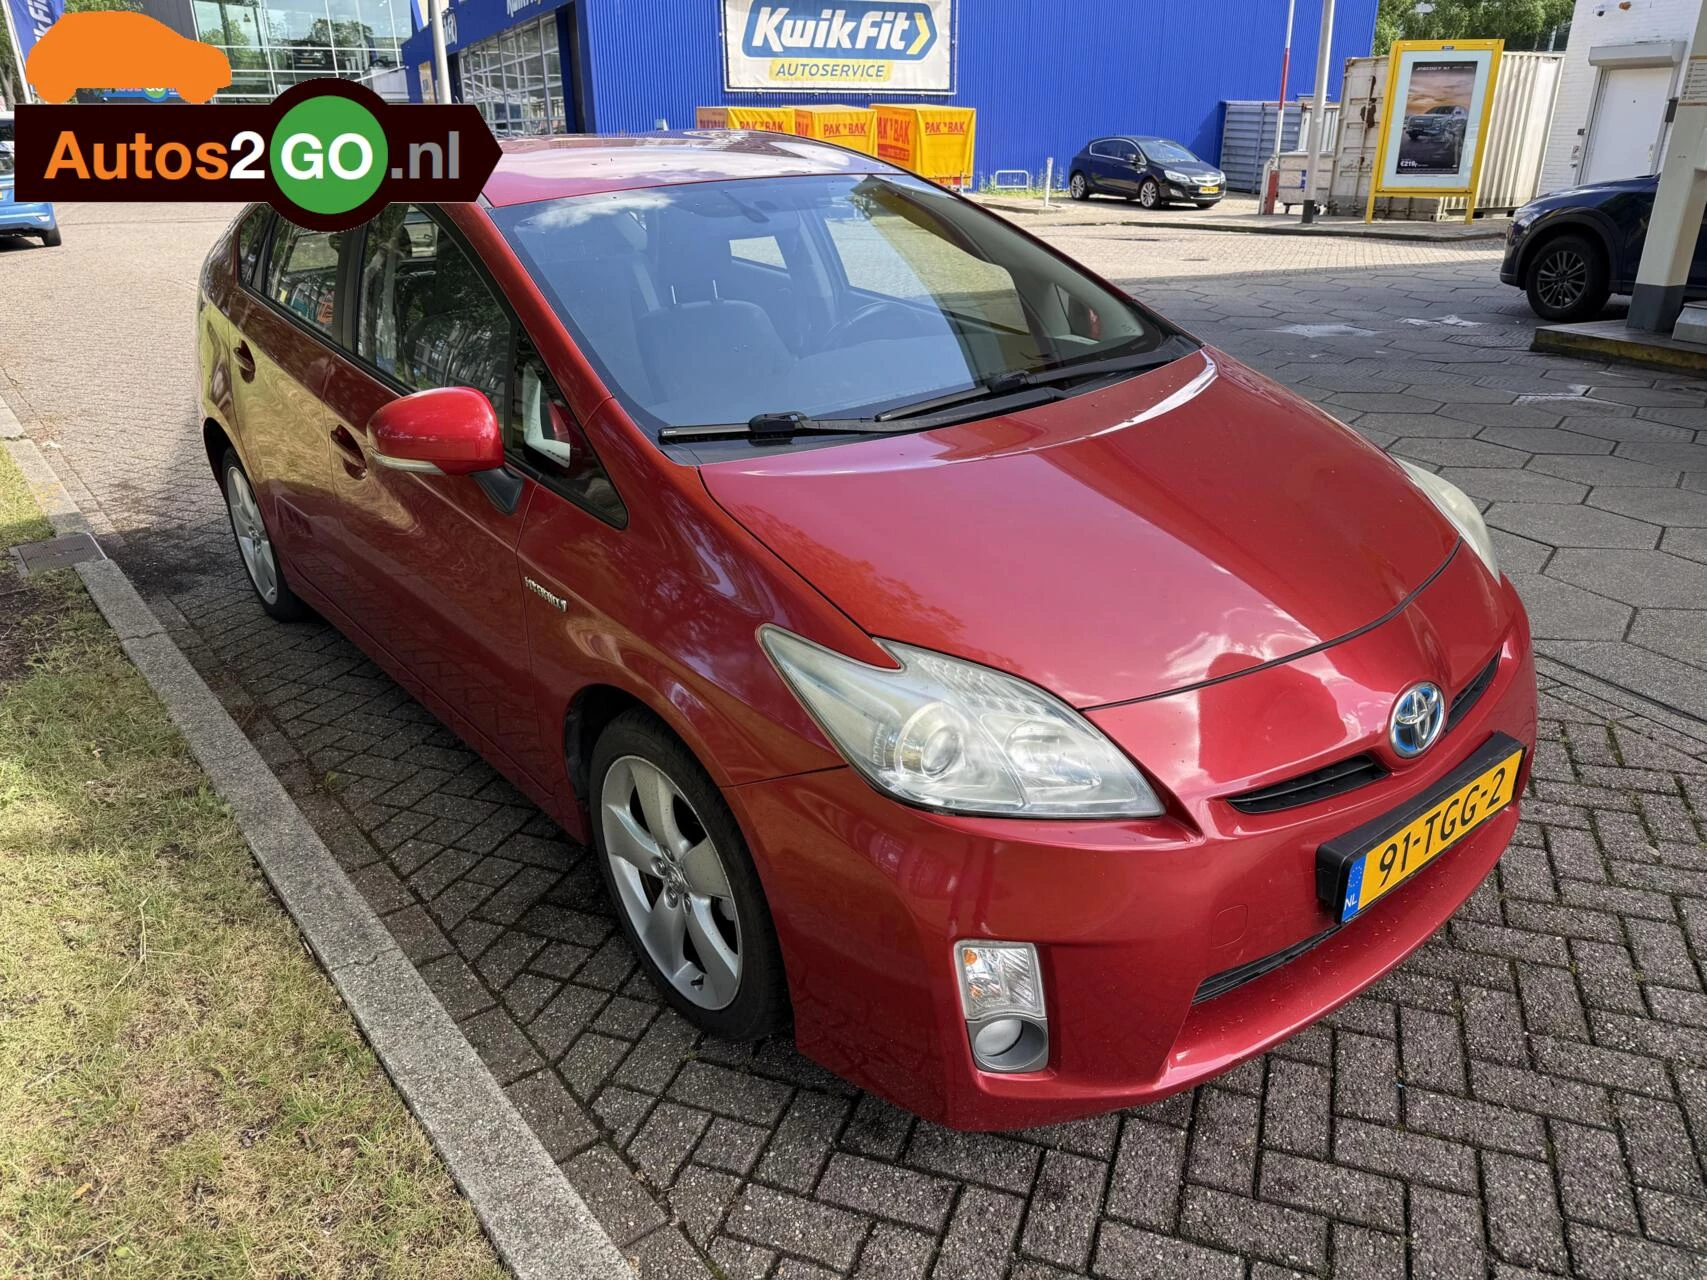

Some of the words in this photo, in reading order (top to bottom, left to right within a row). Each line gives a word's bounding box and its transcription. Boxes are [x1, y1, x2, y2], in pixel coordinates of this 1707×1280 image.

[776, 63, 885, 78] AUTOSERVICE
[823, 123, 841, 135] PAK
[848, 122, 866, 134] BAK
[925, 121, 941, 133] PAK
[947, 121, 965, 133] BAK
[1379, 766, 1505, 888] 91-TGG-2
[1344, 894, 1357, 911] NL
